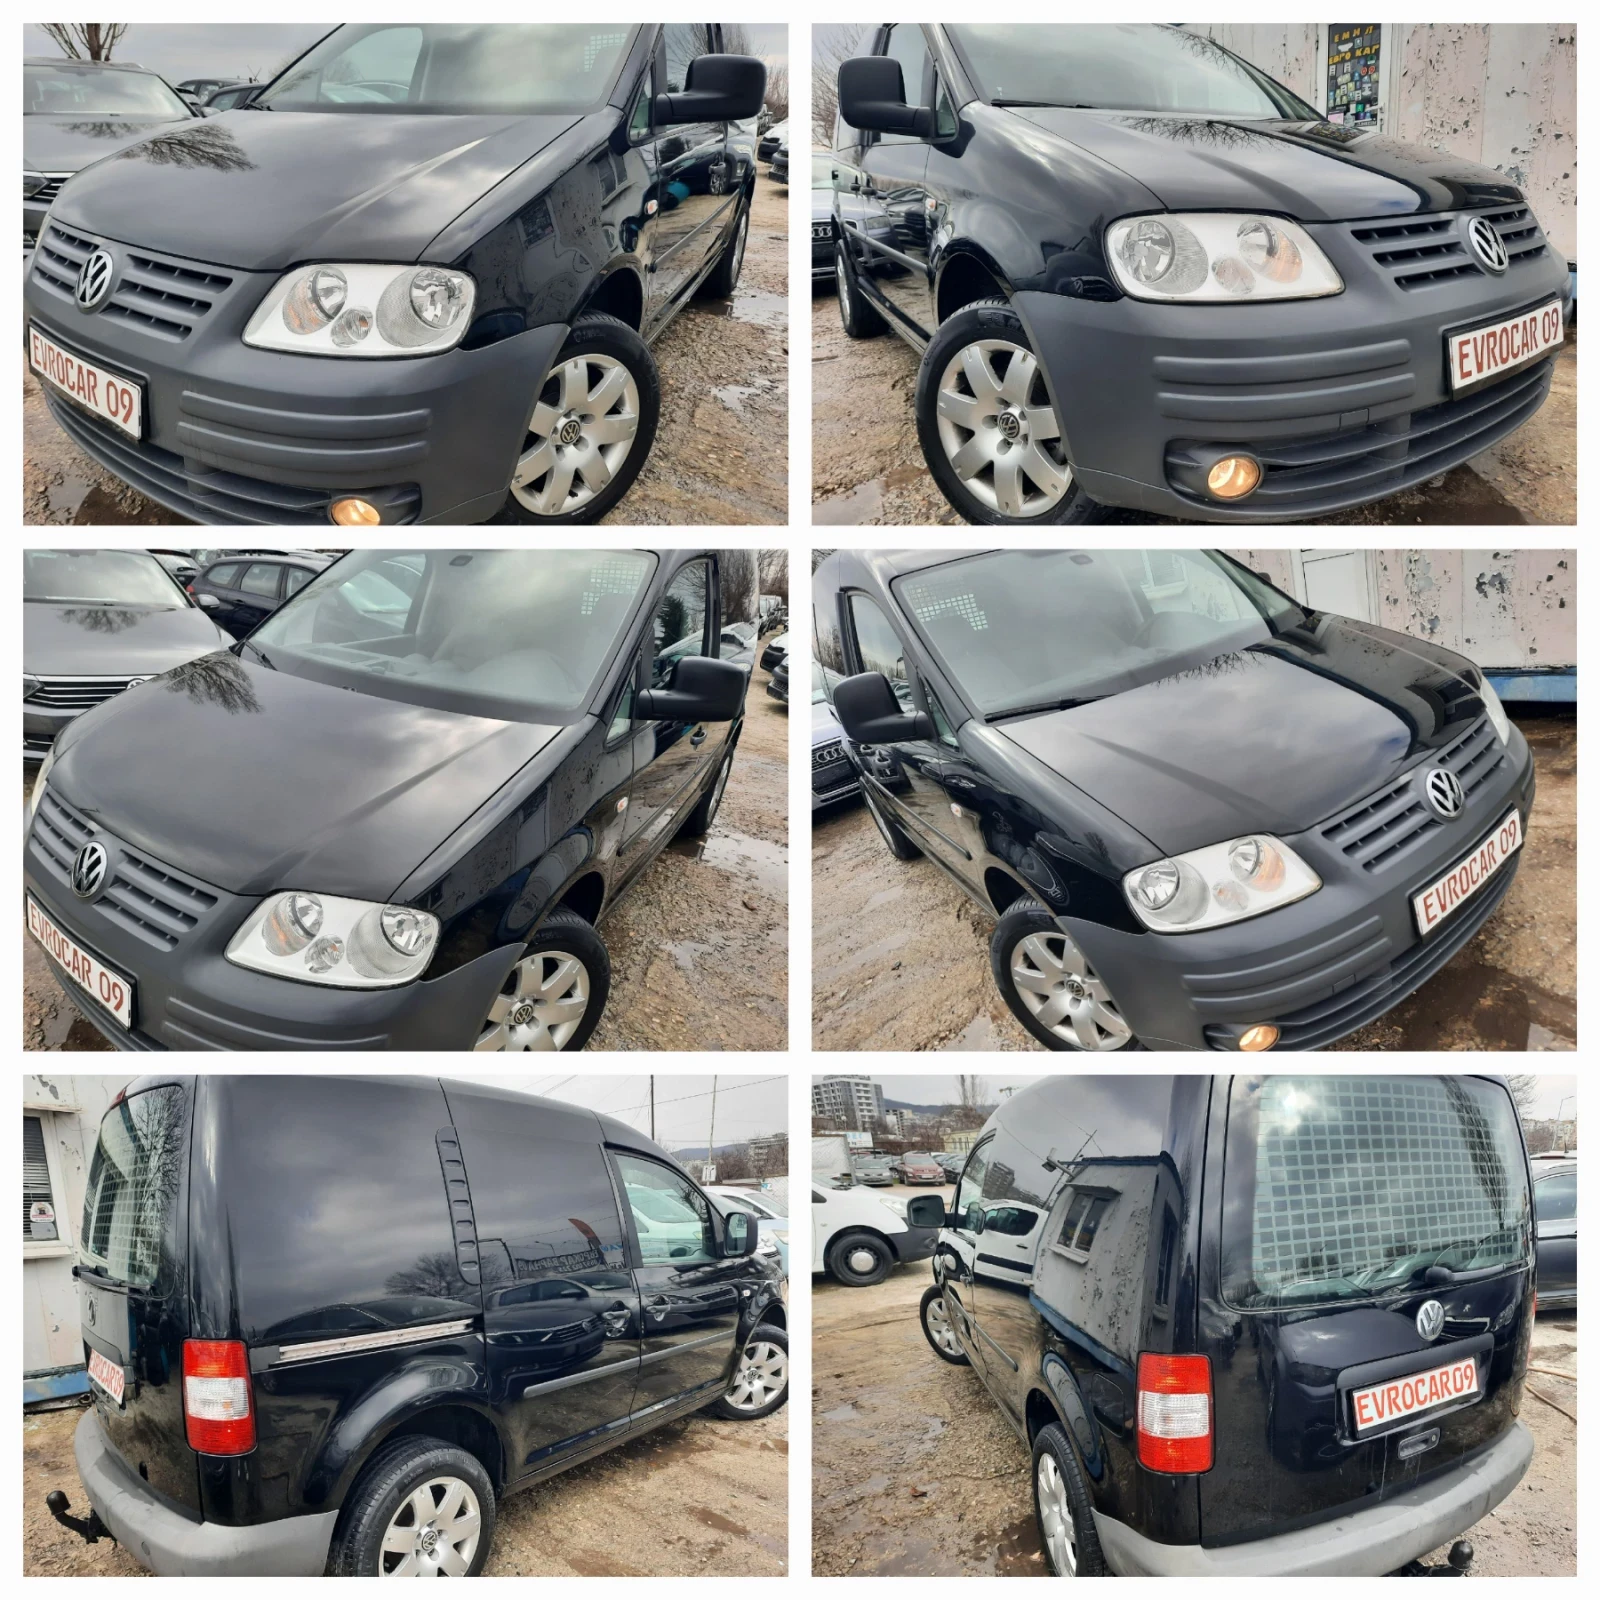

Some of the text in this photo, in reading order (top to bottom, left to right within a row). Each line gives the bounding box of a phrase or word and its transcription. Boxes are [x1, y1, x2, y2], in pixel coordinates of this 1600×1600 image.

[33, 333, 134, 424] EVROCAR 09
[1458, 307, 1559, 380] EVROCAR 09
[1423, 819, 1517, 925] EVROCAR 09
[30, 905, 124, 1012] EVROCAR 09
